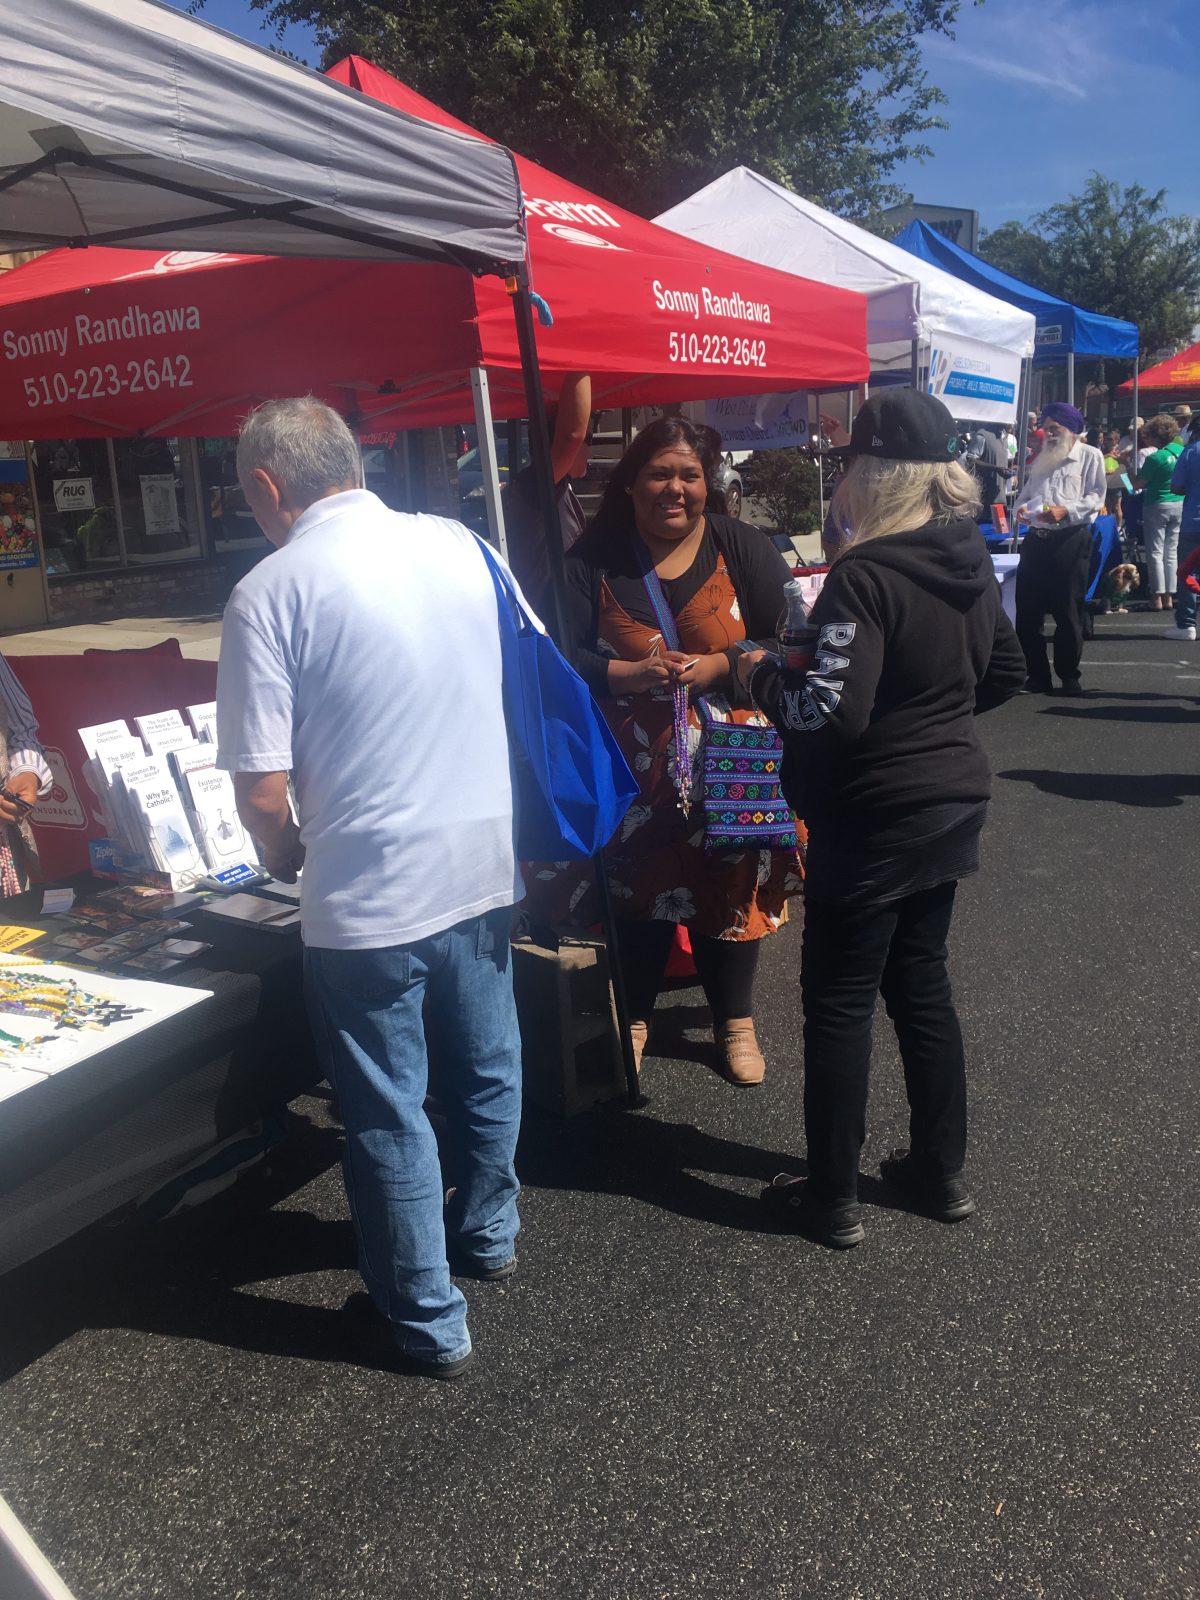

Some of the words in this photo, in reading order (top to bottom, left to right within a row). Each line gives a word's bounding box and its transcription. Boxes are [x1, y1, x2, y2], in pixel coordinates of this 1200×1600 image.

[653, 280, 699, 320] Sonny
[702, 286, 770, 324] Randhawa
[3, 330, 68, 360] Sonny
[75, 305, 200, 346] Randhawa
[670, 332, 766, 367] 510-223-2642
[24, 355, 192, 408] 510-223-2642
[63, 486, 86, 497] RUG
[120, 752, 135, 760] Bible
[198, 776, 223, 788] Existence
[146, 792, 160, 802] Why
[146, 796, 173, 808] Catholic?
